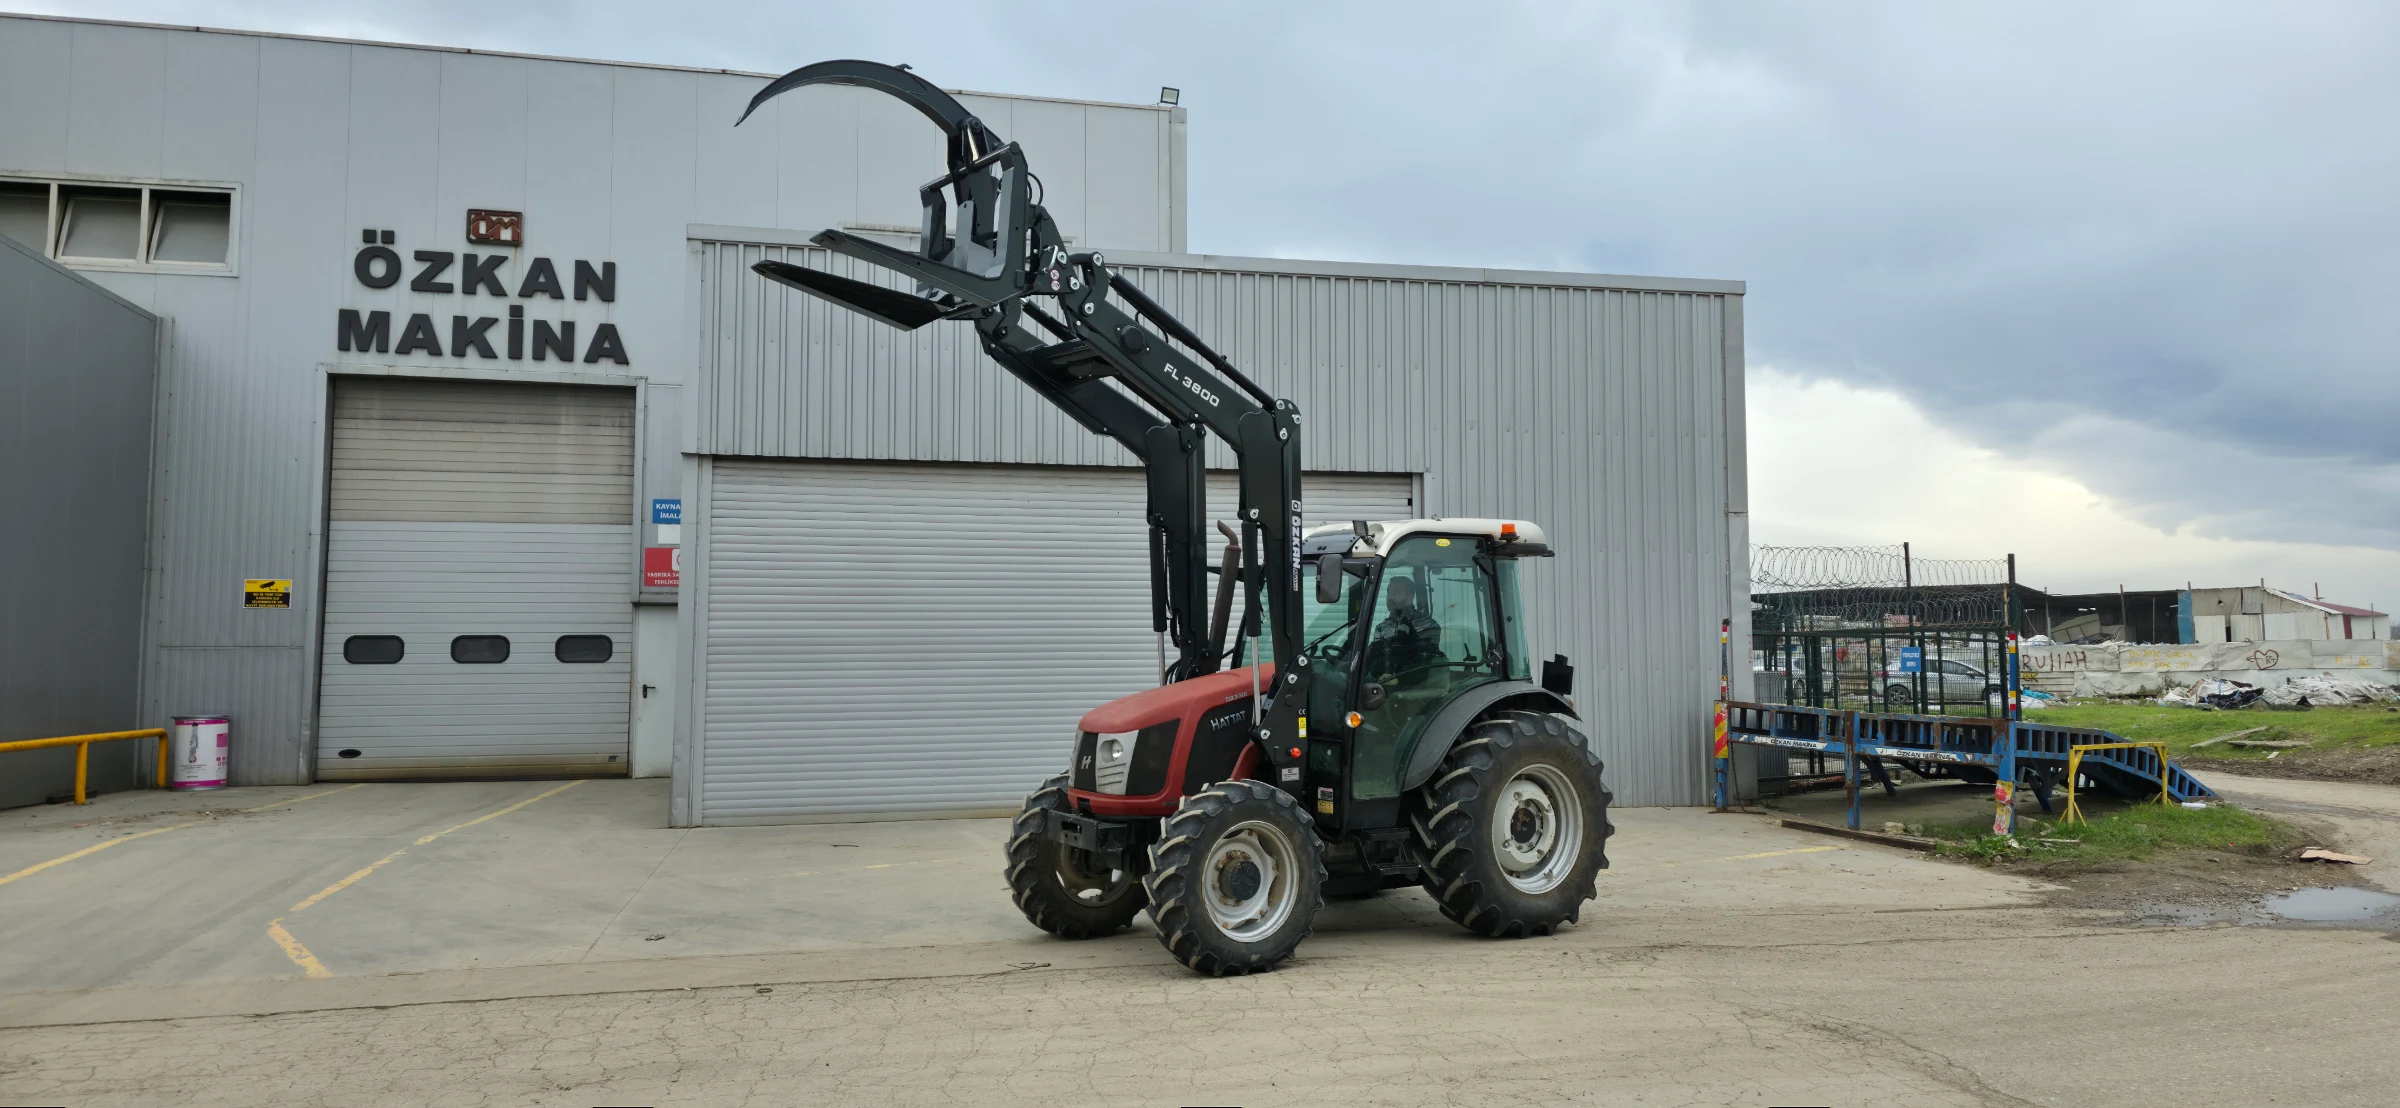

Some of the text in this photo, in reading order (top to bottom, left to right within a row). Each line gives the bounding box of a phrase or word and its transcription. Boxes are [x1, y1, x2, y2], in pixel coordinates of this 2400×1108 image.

[354, 229, 616, 302] ÖZKAN
[337, 304, 629, 365] MAKİNA
[1163, 362, 1220, 407] FL 3800
[1210, 710, 1246, 731] HATTAT
